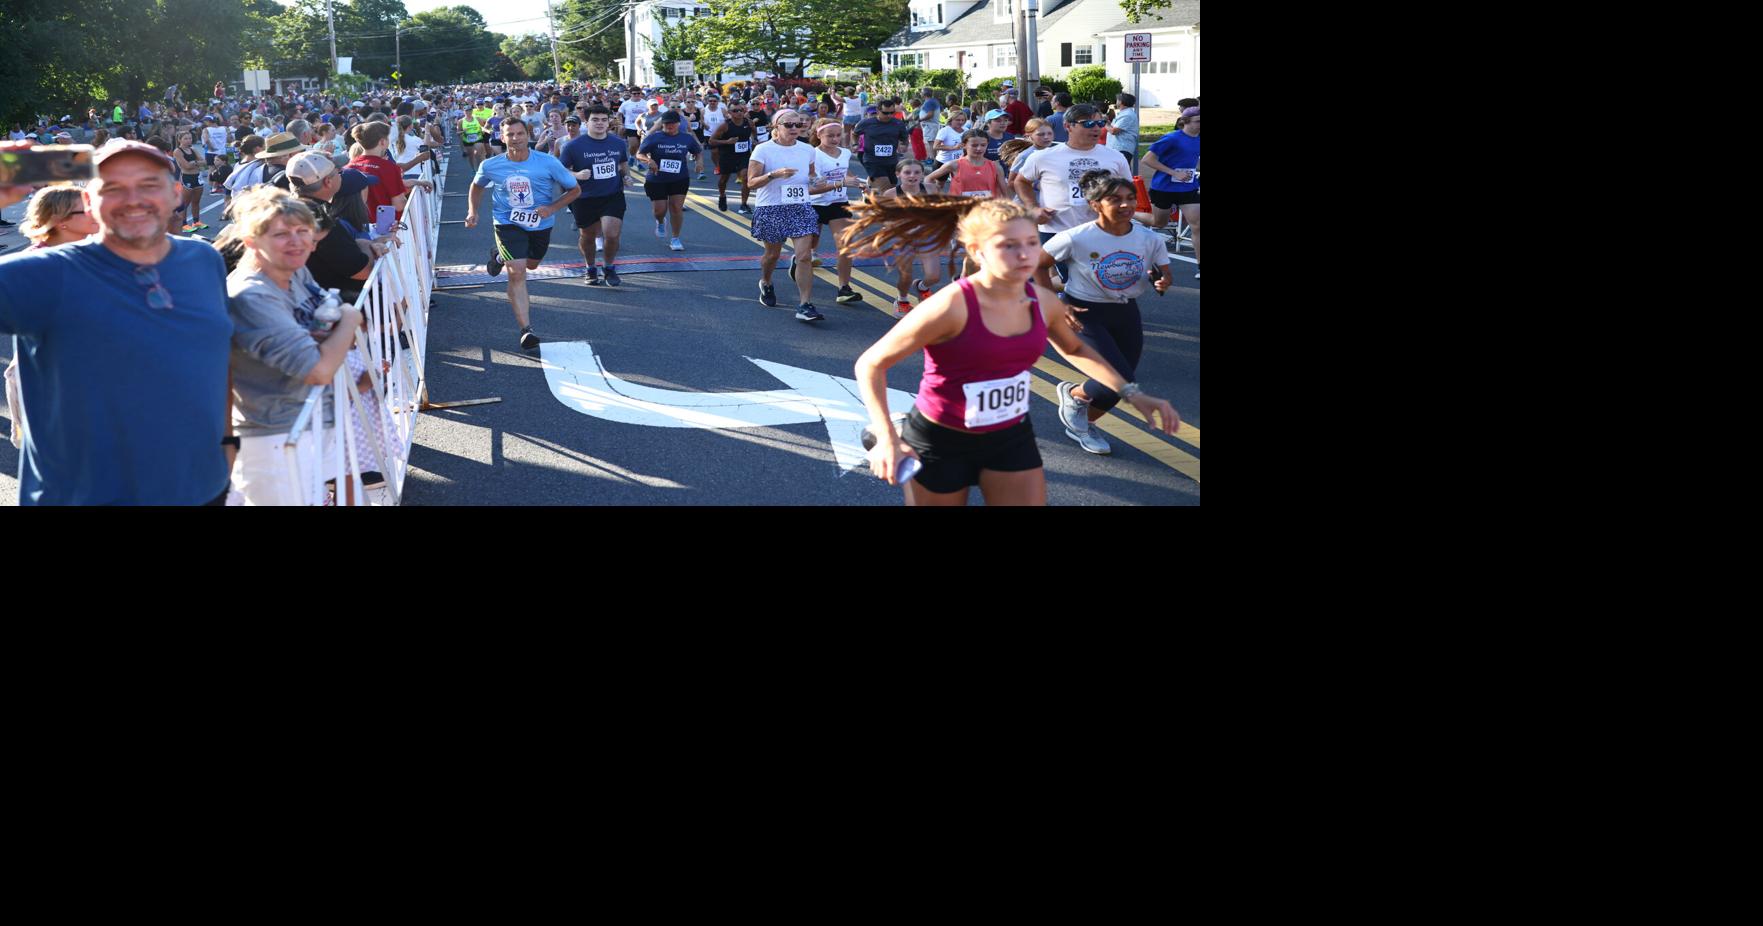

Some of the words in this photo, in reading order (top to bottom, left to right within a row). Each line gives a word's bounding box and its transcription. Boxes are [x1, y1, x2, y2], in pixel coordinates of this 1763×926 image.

[596, 164, 615, 175] 1568
[662, 161, 680, 170] 1563
[786, 187, 804, 198] 393
[511, 211, 539, 223] 2619
[976, 380, 1026, 412] 1096
